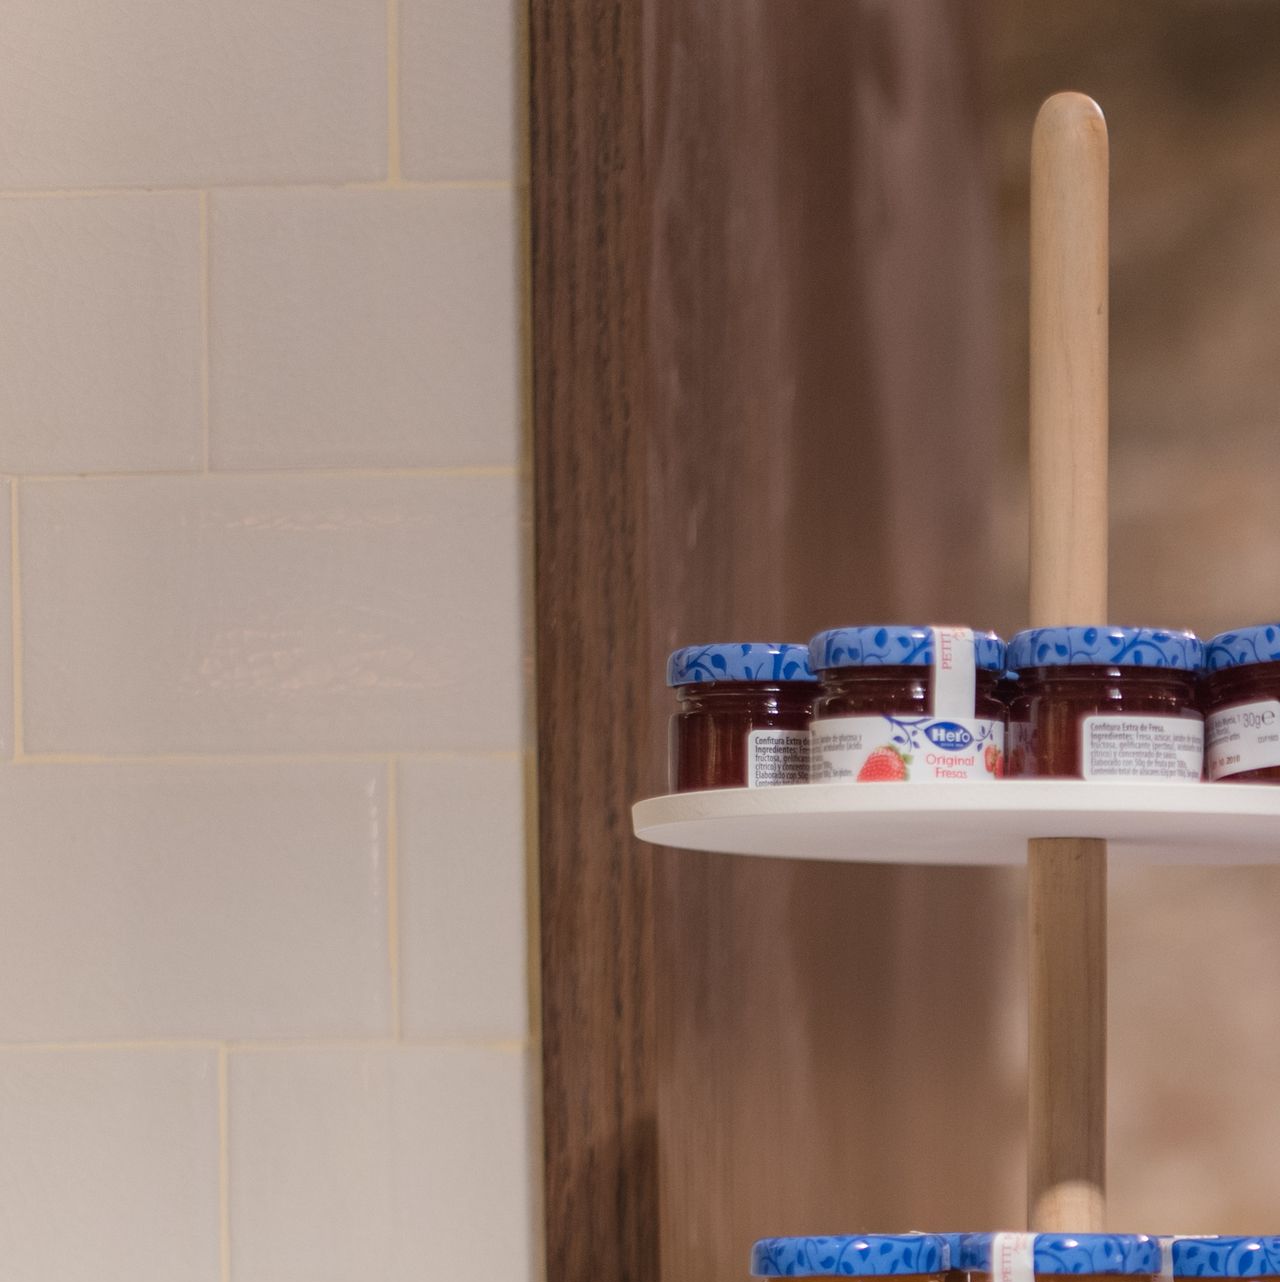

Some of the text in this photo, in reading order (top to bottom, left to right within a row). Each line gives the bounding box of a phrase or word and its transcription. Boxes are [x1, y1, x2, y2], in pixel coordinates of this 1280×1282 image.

[941, 632, 952, 670] PETIT
[932, 729, 970, 742] Hero
[926, 752, 974, 767] Original
[936, 767, 968, 779] Fresas
